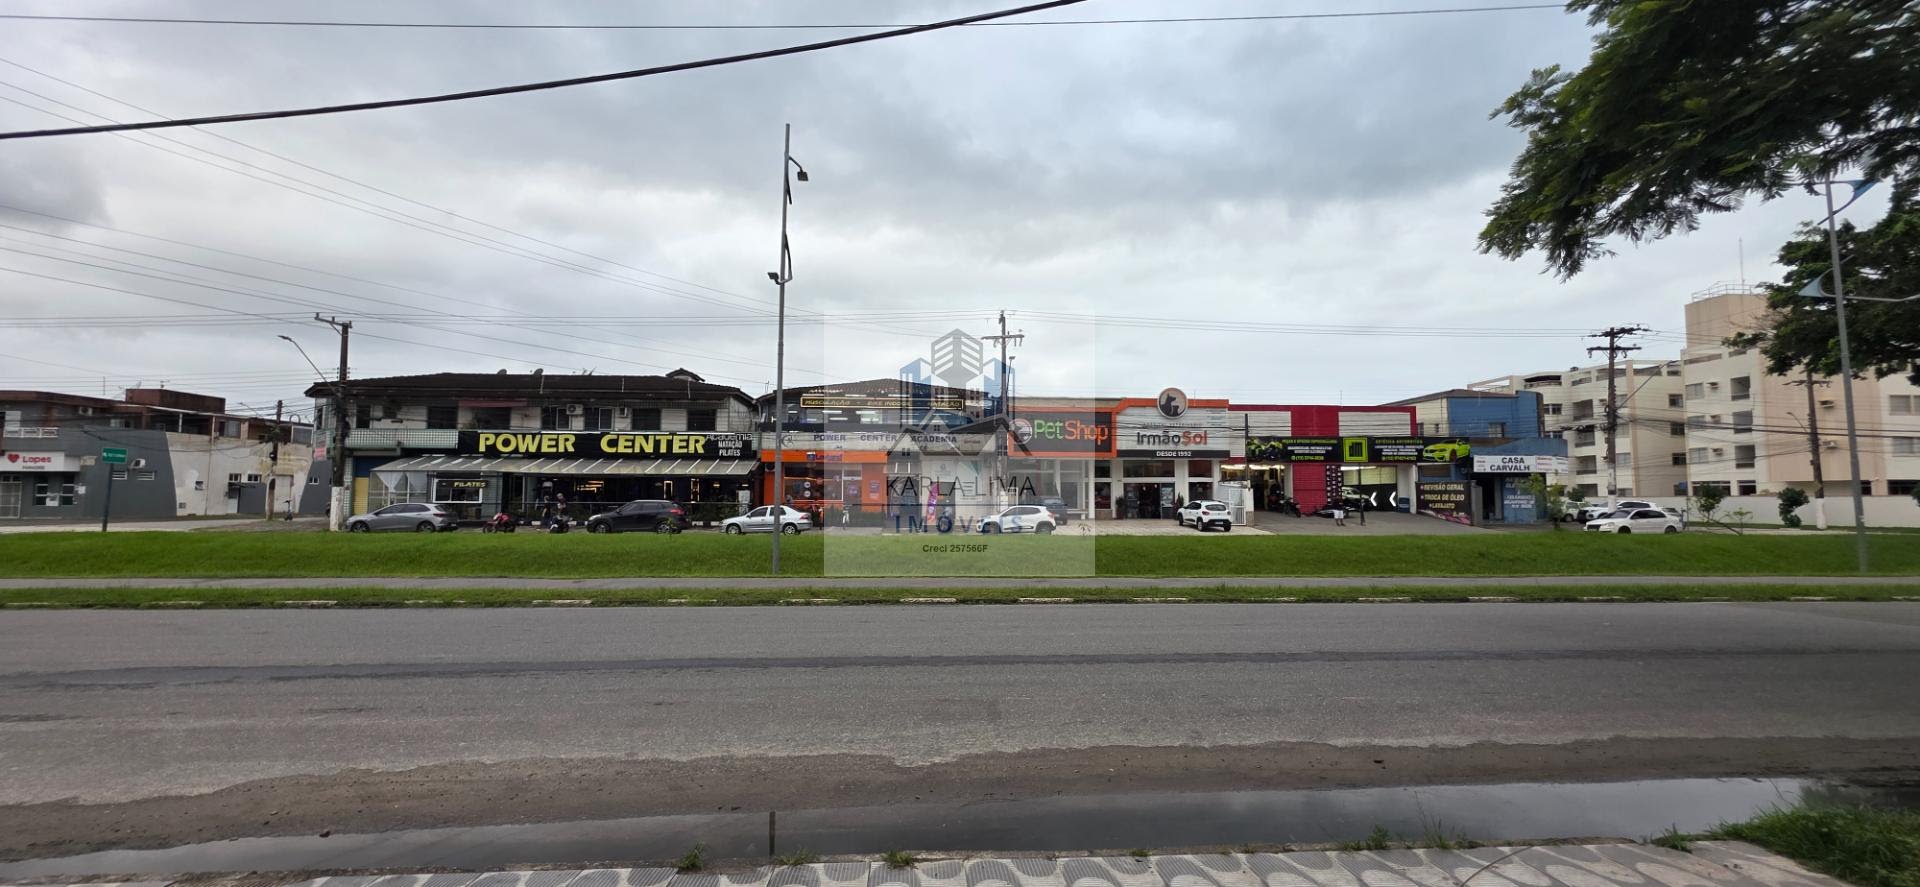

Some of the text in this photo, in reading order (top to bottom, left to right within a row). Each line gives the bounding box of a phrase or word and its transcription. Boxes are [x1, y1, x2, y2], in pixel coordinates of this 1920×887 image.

[860, 434, 897, 442] CENTER
[912, 435, 957, 443] ACADEMIA
[479, 433, 705, 454] POWER CENTER
[718, 440, 743, 448] NATAÇÃO
[23, 456, 51, 464] Lopes
[1450, 493, 1465, 501] ÓLEO
